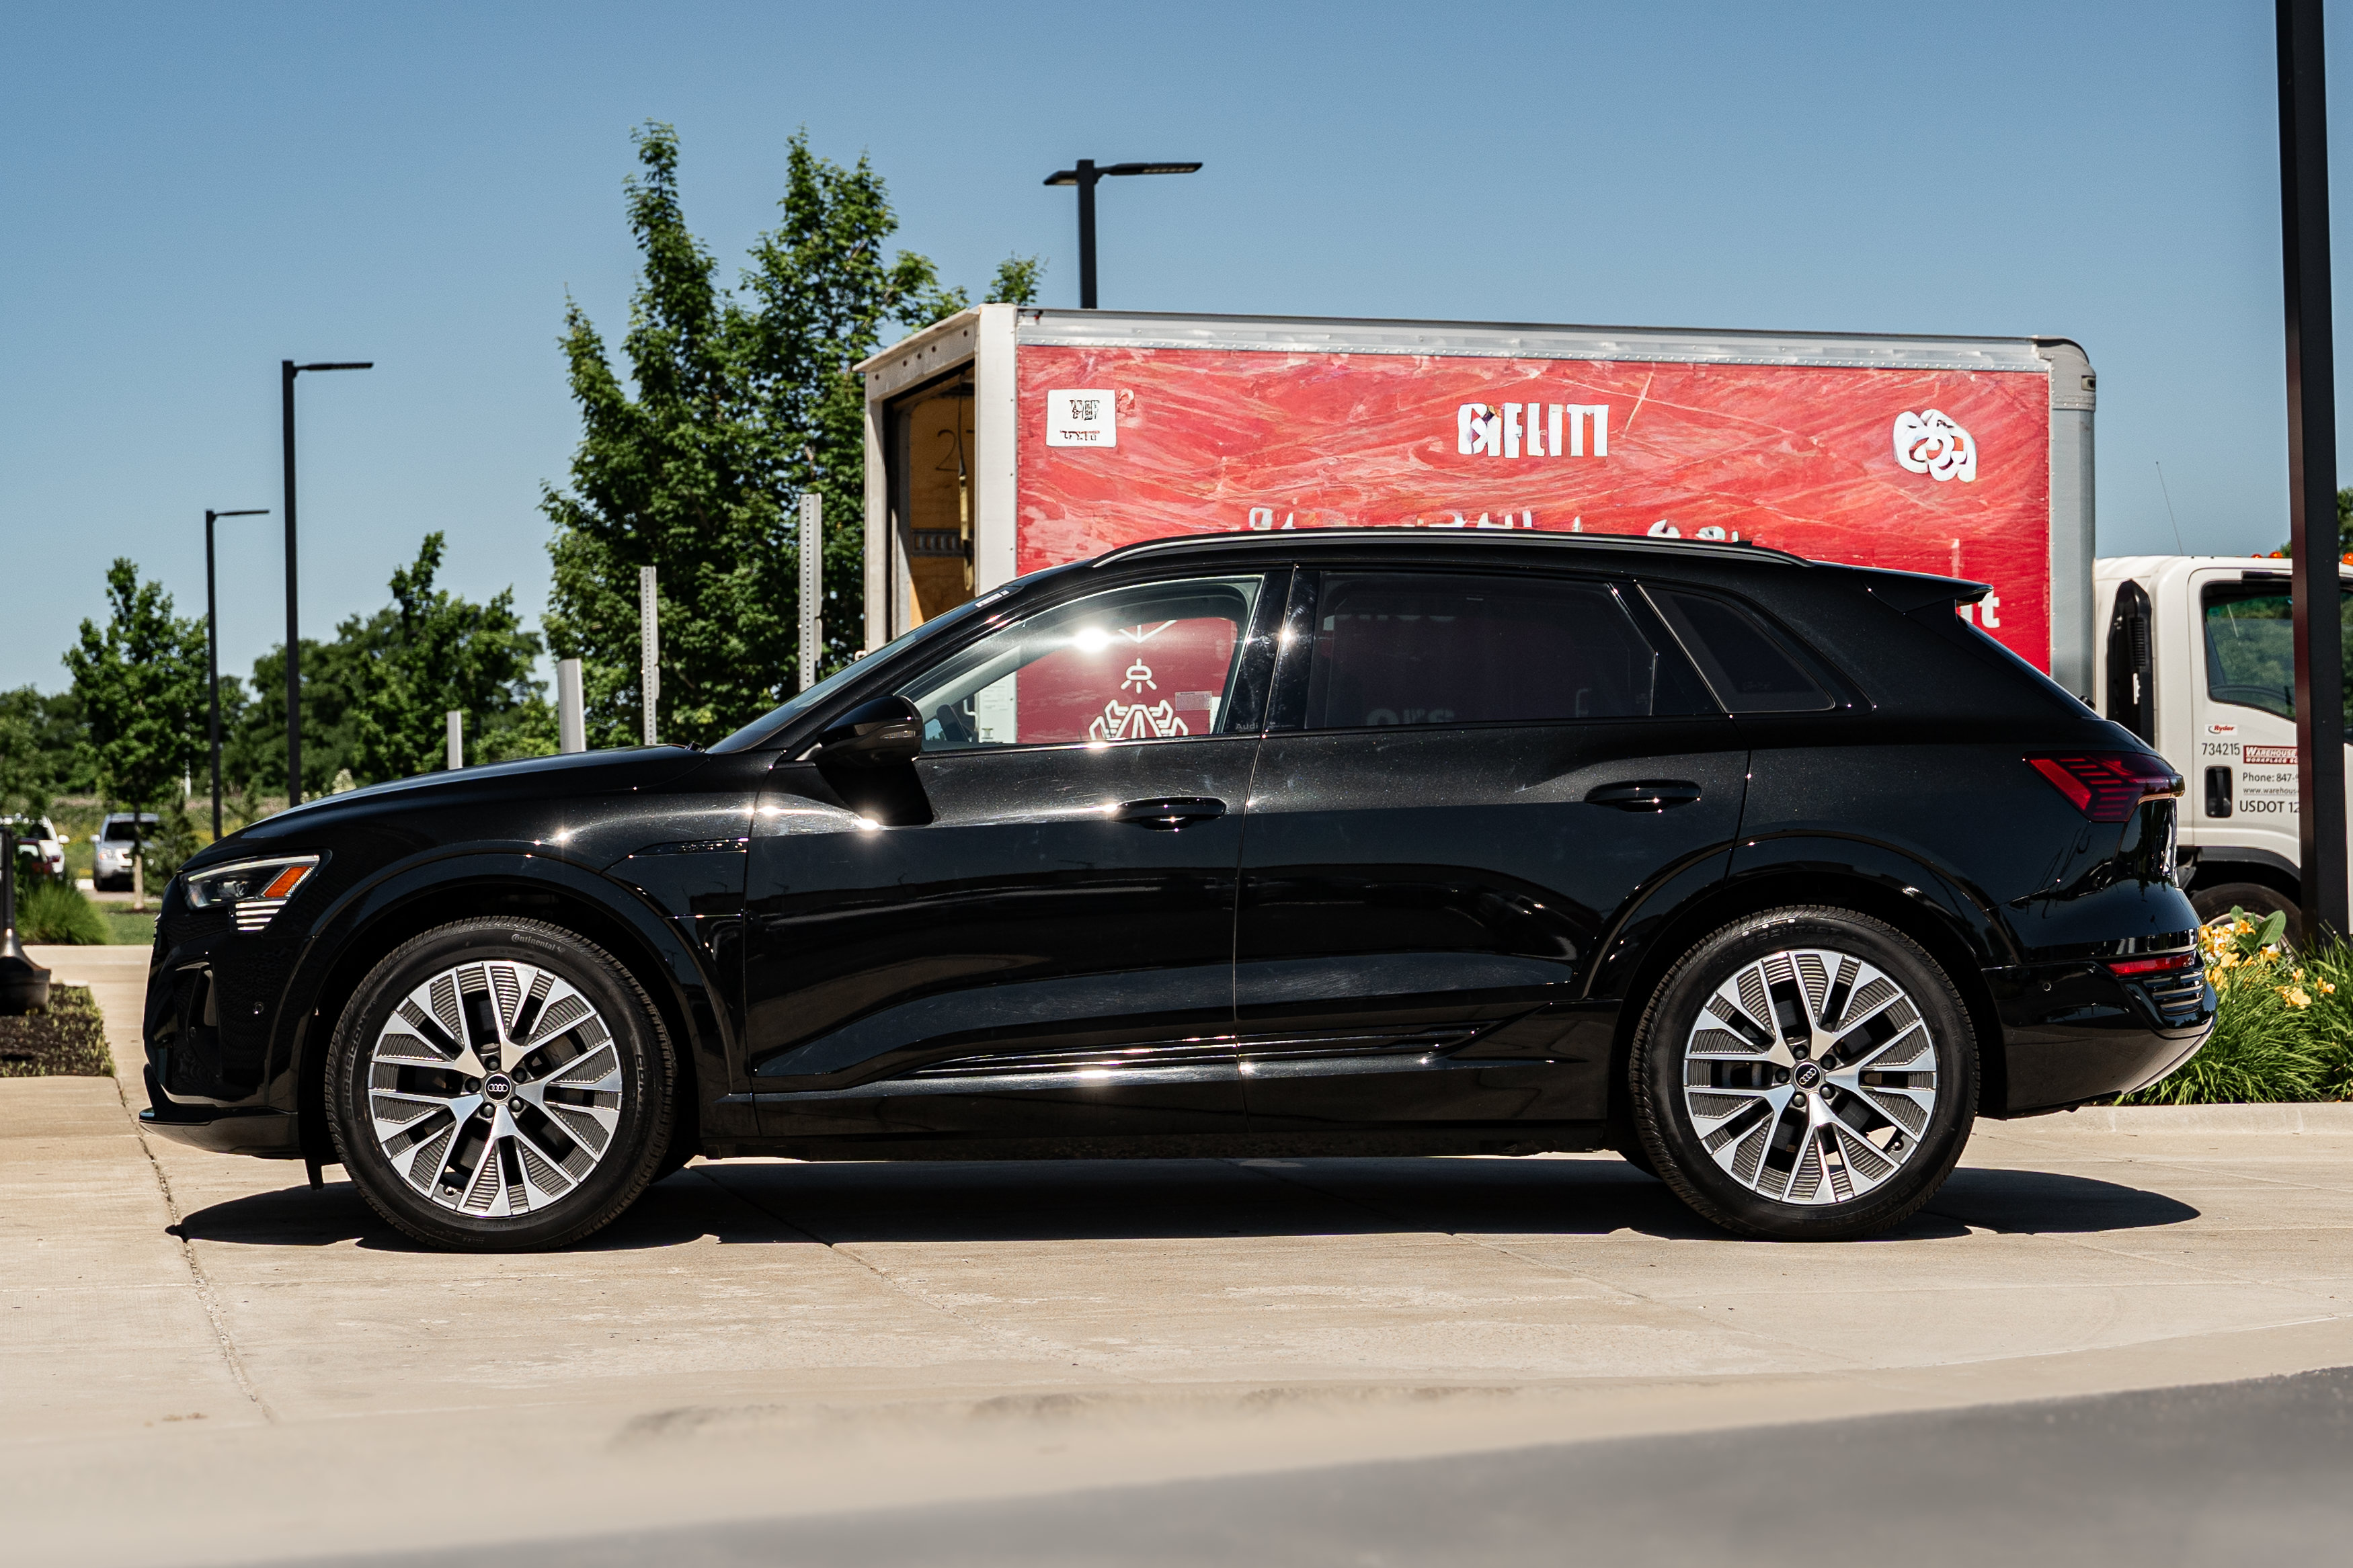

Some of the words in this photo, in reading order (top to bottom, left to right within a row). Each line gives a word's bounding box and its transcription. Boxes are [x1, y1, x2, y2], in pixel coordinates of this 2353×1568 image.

[1235, 723, 1259, 731] Audi
[2202, 743, 2240, 755] 734215
[2242, 772, 2274, 782] Phone:
[2239, 800, 2285, 813] USDOT
[511, 934, 556, 951] Continental
